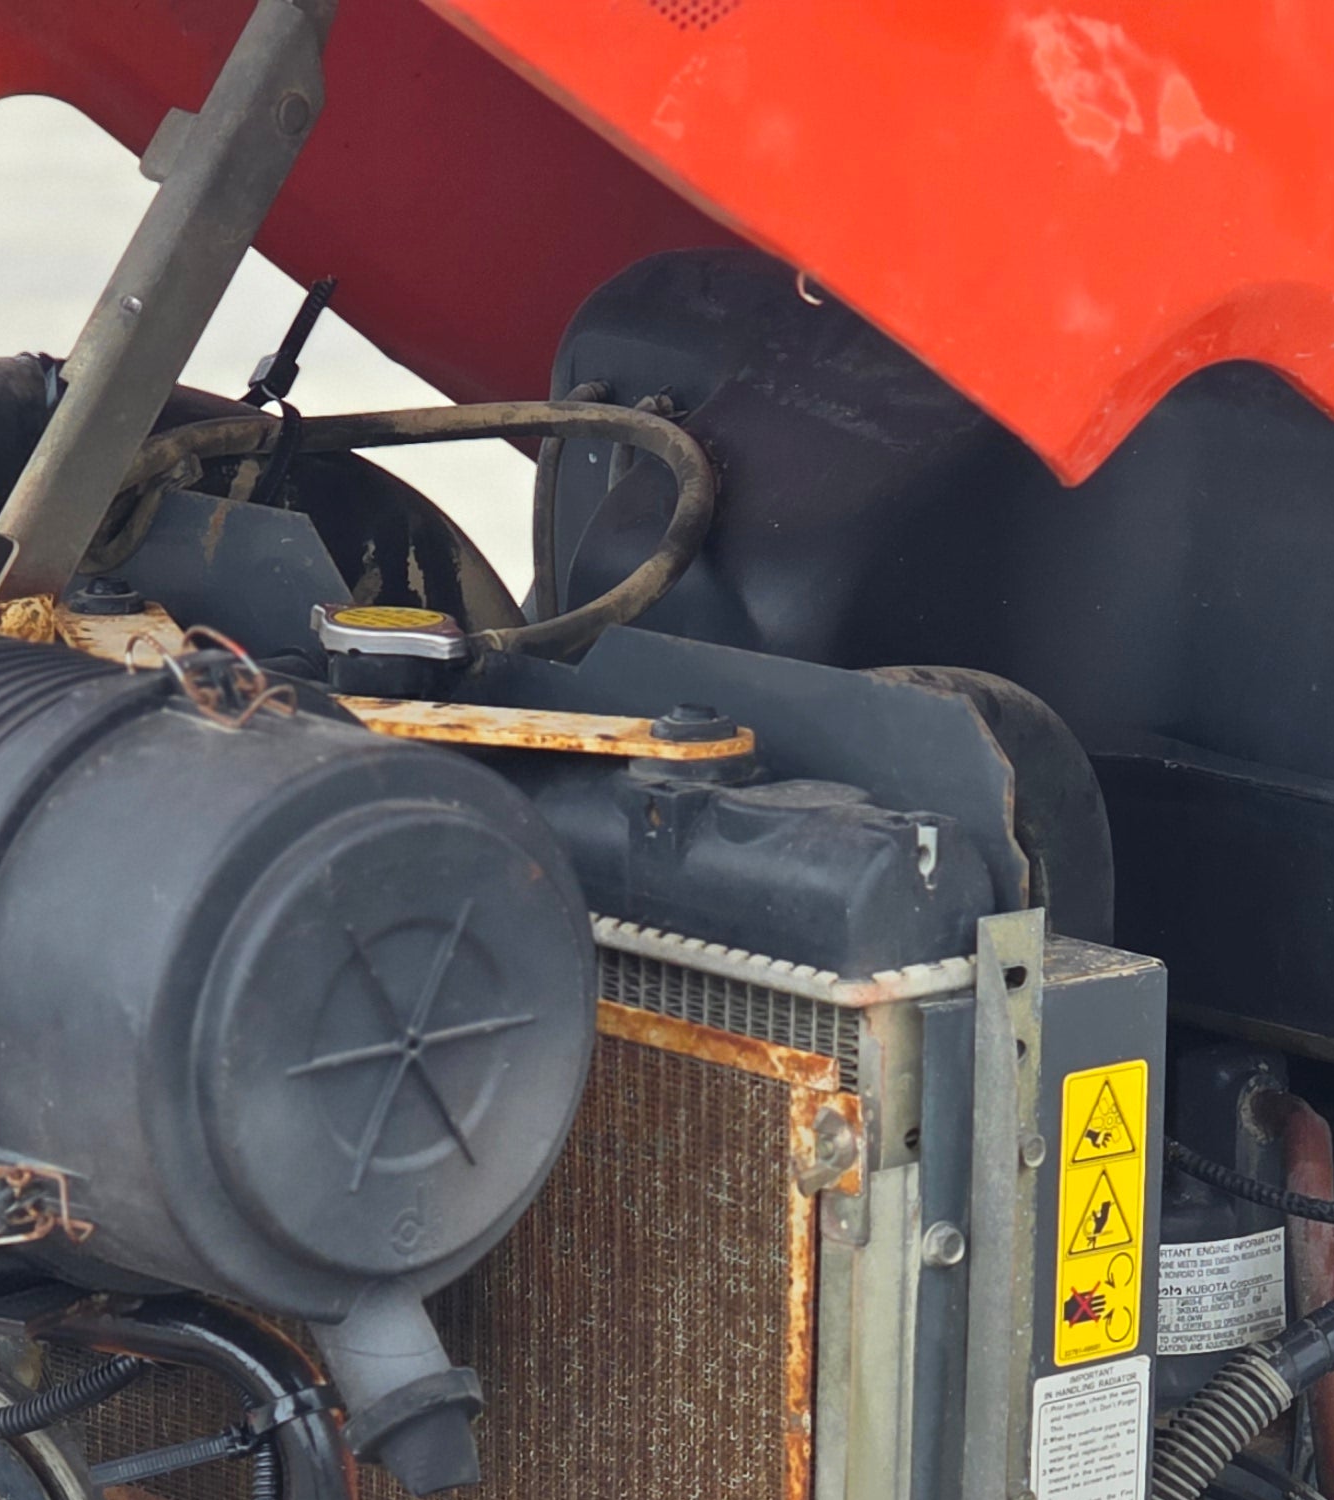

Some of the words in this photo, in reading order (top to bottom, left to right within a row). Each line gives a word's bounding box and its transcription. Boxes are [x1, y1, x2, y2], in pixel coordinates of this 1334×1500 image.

[1197, 1245, 1229, 1256] ENGINE
[1234, 1234, 1280, 1251] INFORMATION
[1186, 1282, 1228, 1294] KUBOTA
[1231, 1274, 1273, 1290] Corporation
[1055, 1383, 1095, 1397] HANDLING
[1099, 1373, 1137, 1387] RADIATOR
[1070, 1367, 1114, 1384] IMPORTANT
